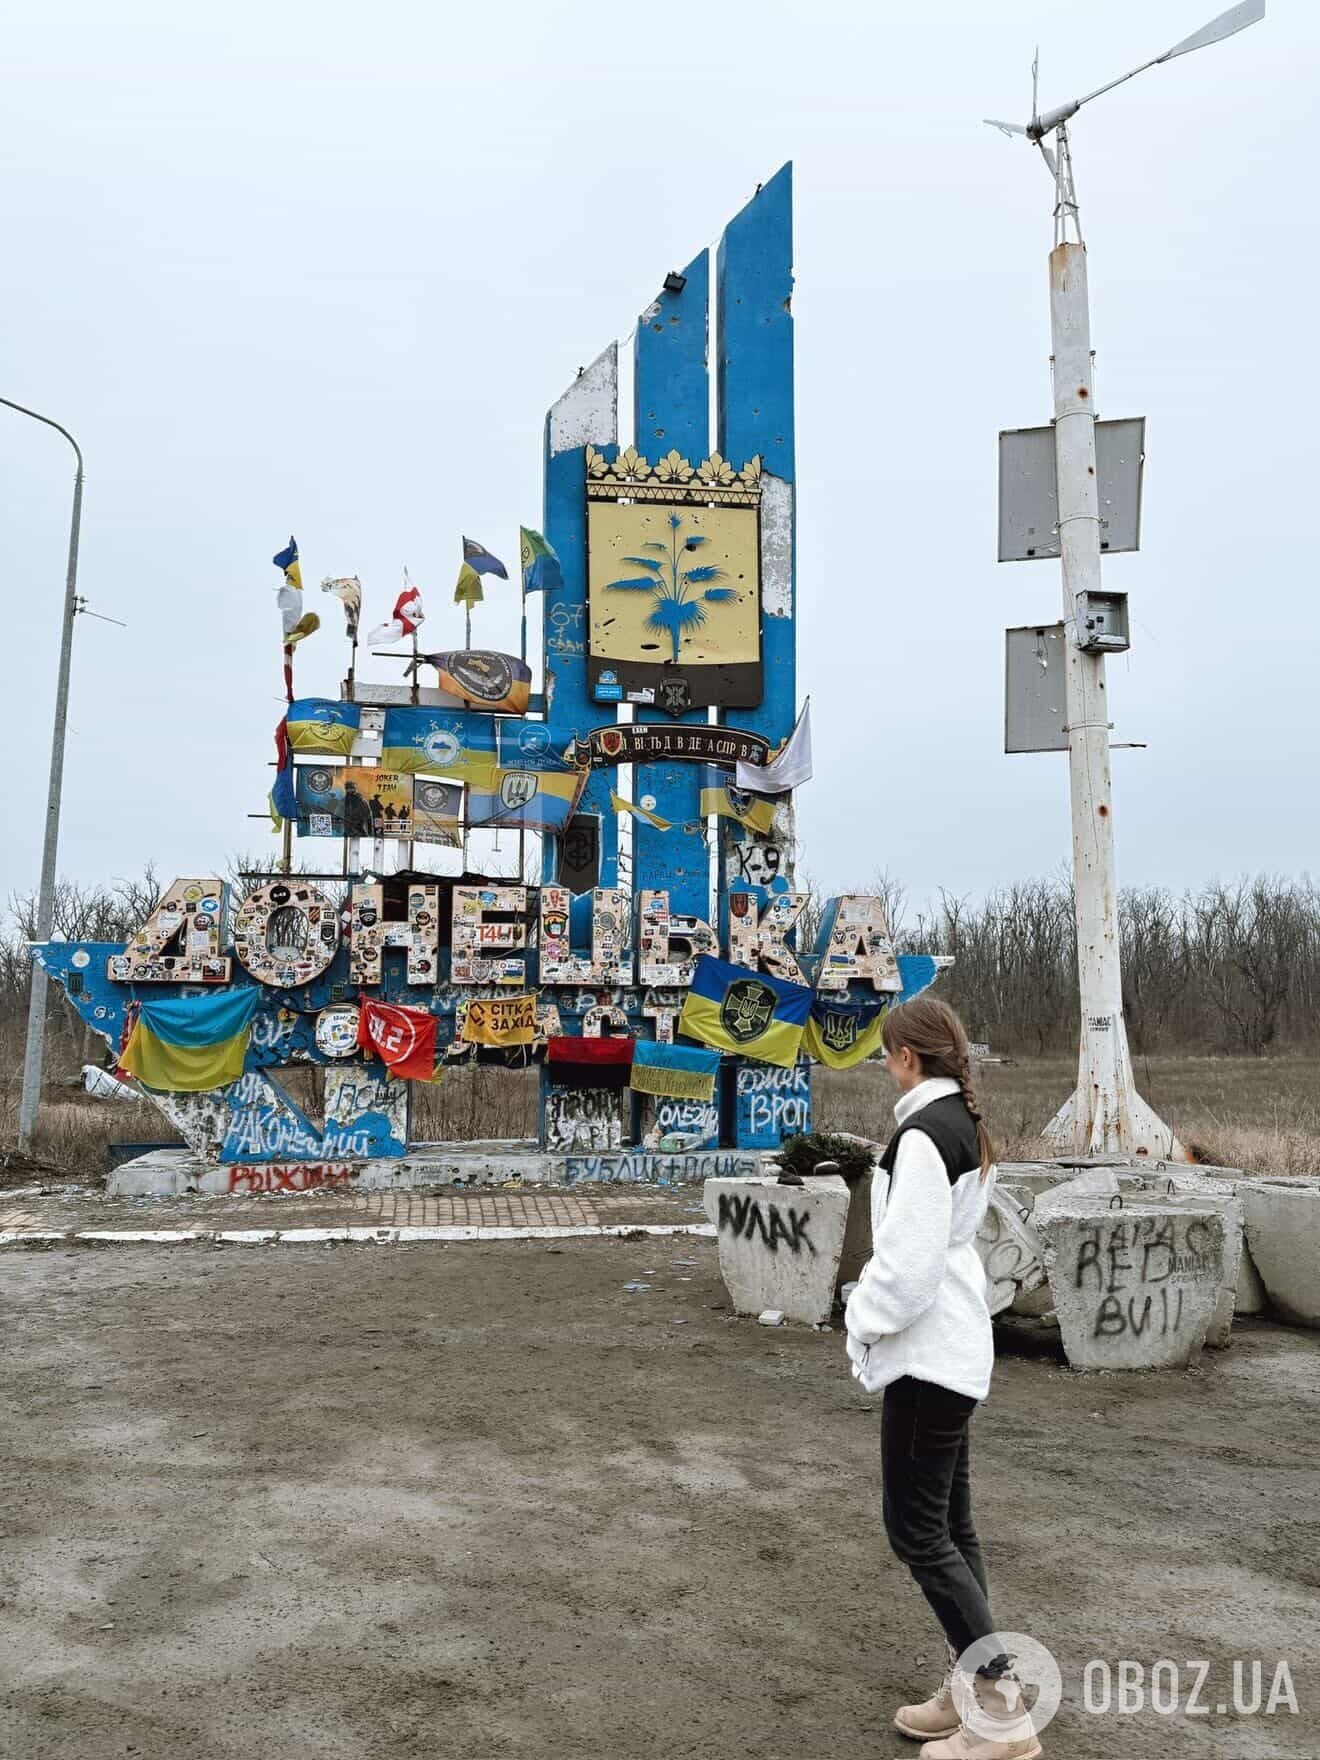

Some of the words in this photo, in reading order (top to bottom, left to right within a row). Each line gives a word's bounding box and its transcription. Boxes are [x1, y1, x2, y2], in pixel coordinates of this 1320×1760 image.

[375, 774, 399, 783] JOKER
[107, 878, 903, 992] ДОНЕЦЬКА
[490, 1002, 534, 1016] СІТКА
[490, 1017, 537, 1031] ЗАХІД
